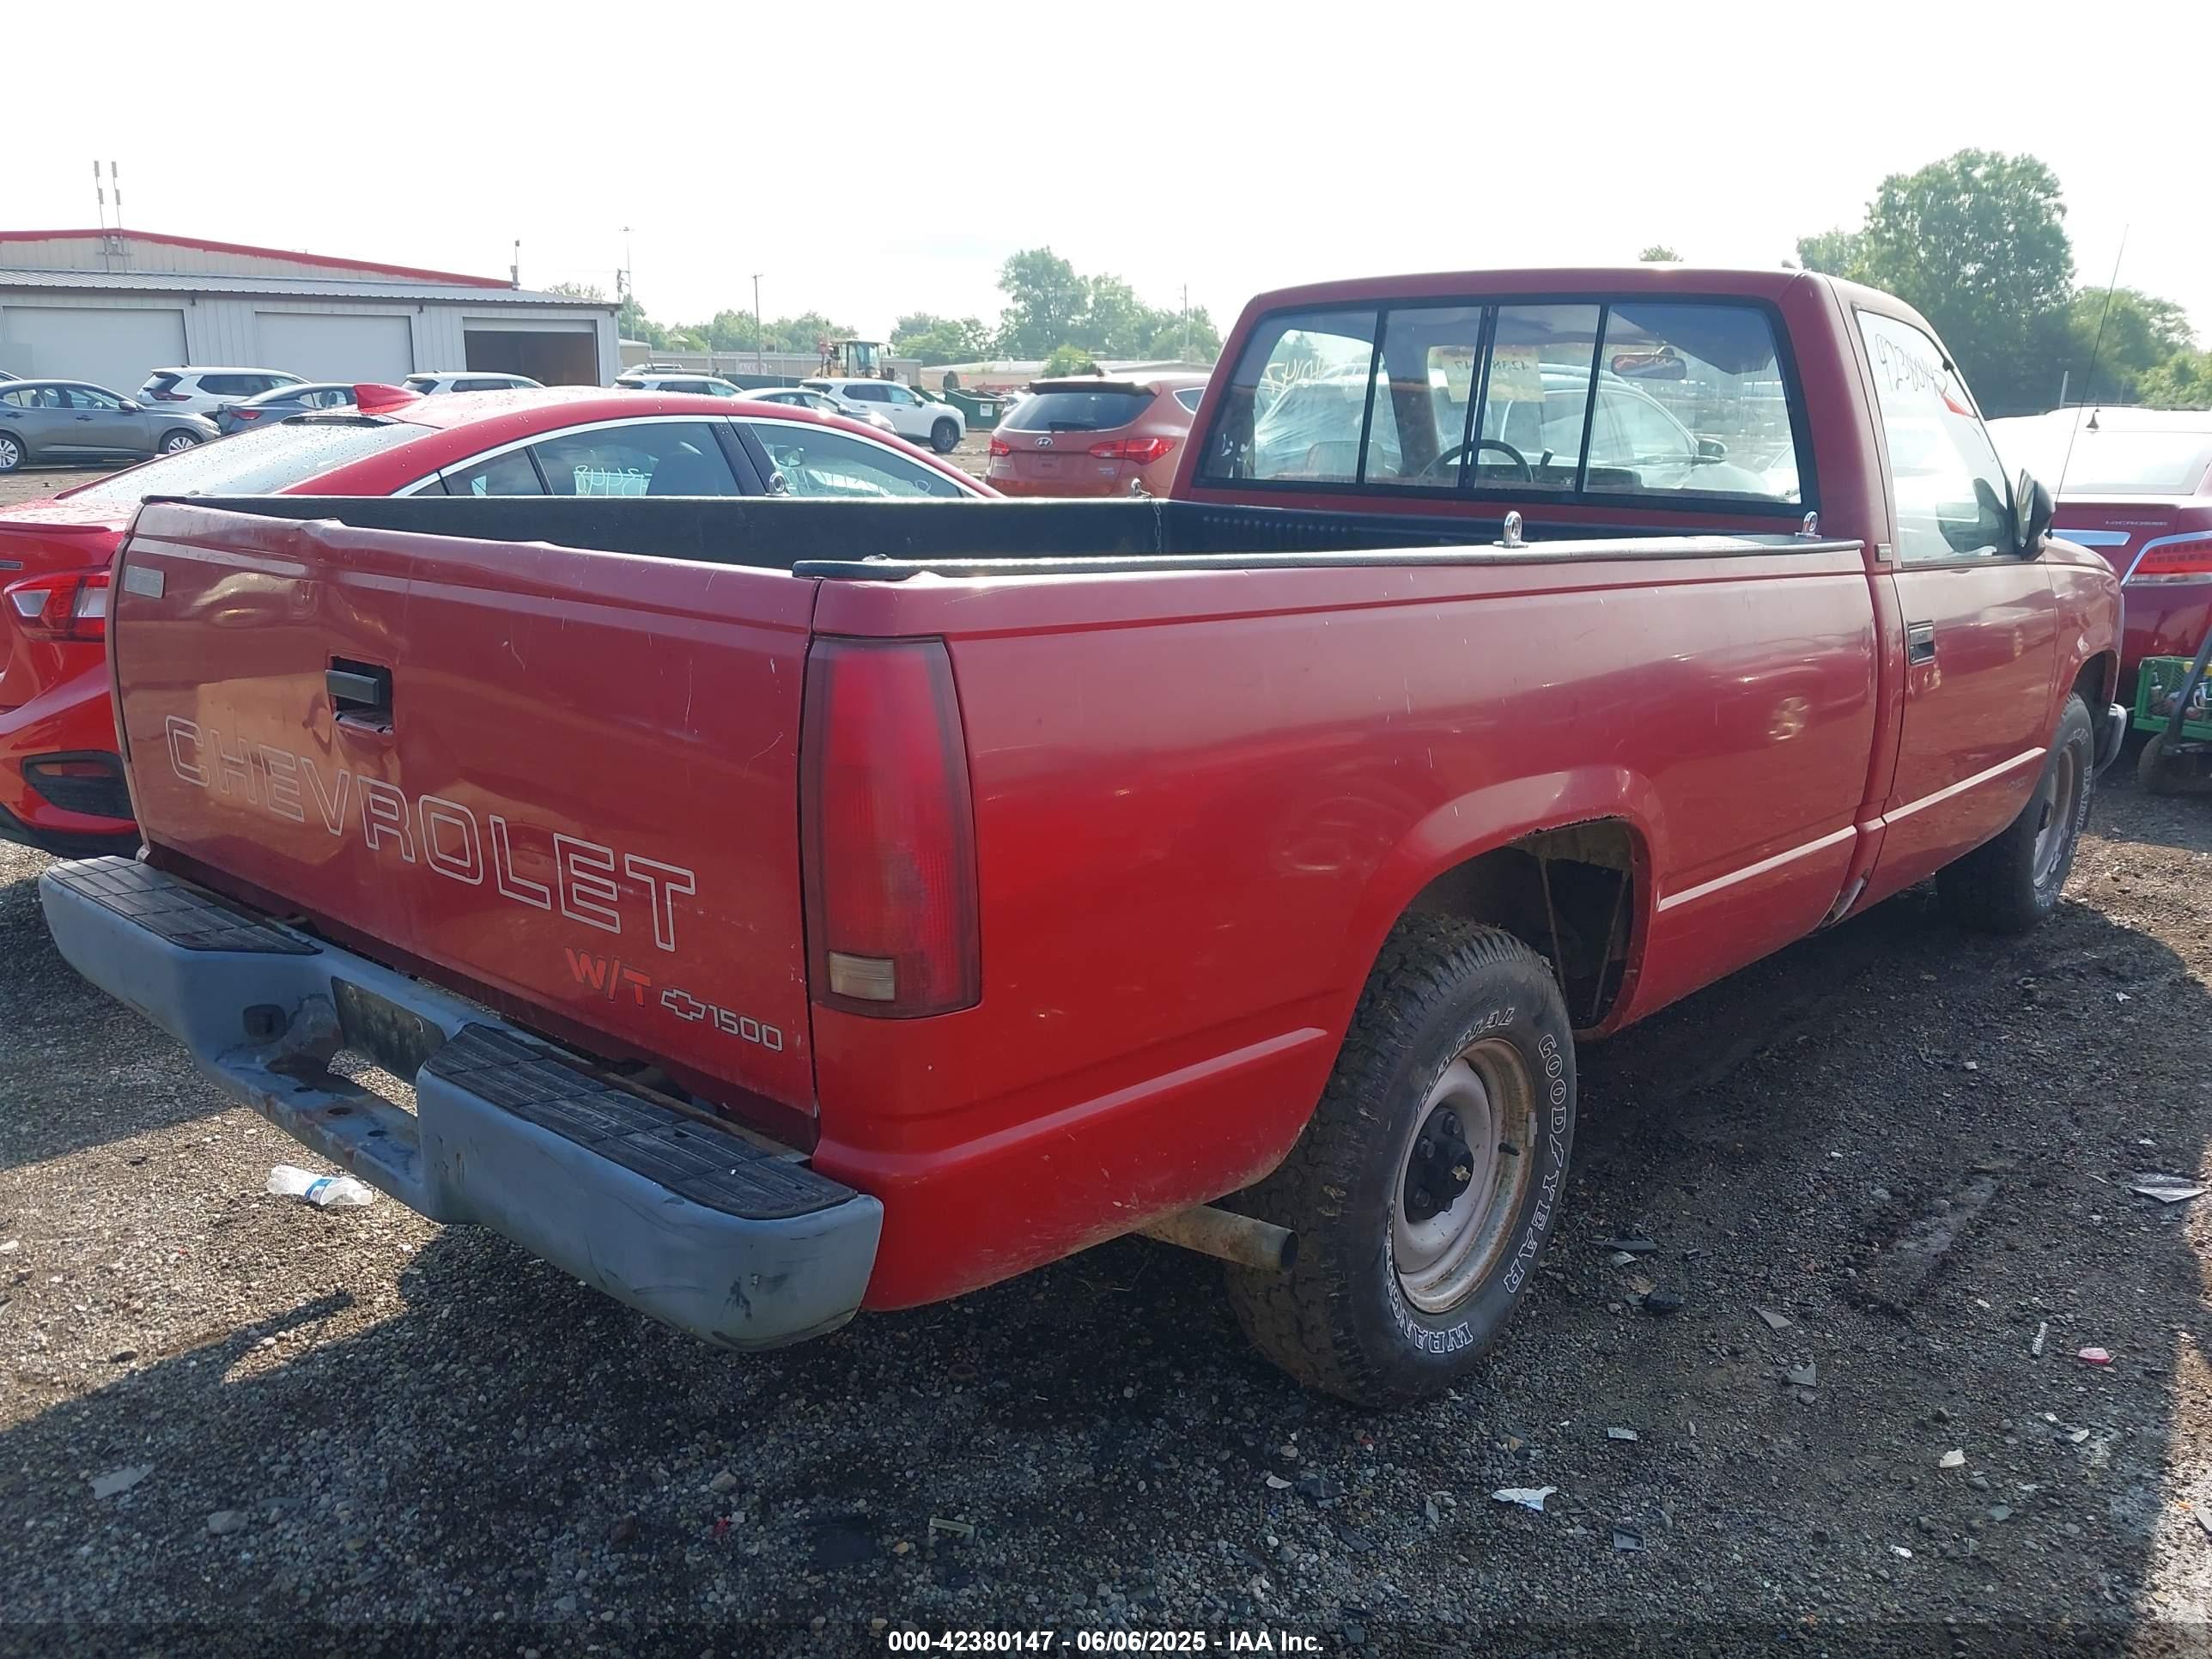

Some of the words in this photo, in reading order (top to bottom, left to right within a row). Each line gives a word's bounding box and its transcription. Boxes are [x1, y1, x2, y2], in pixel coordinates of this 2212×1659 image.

[165, 714, 697, 953] CHEVROLET
[564, 946, 652, 1006] W/T
[708, 1004, 784, 1053] 1500
[1503, 1033, 1567, 1295] GOODYEAR
